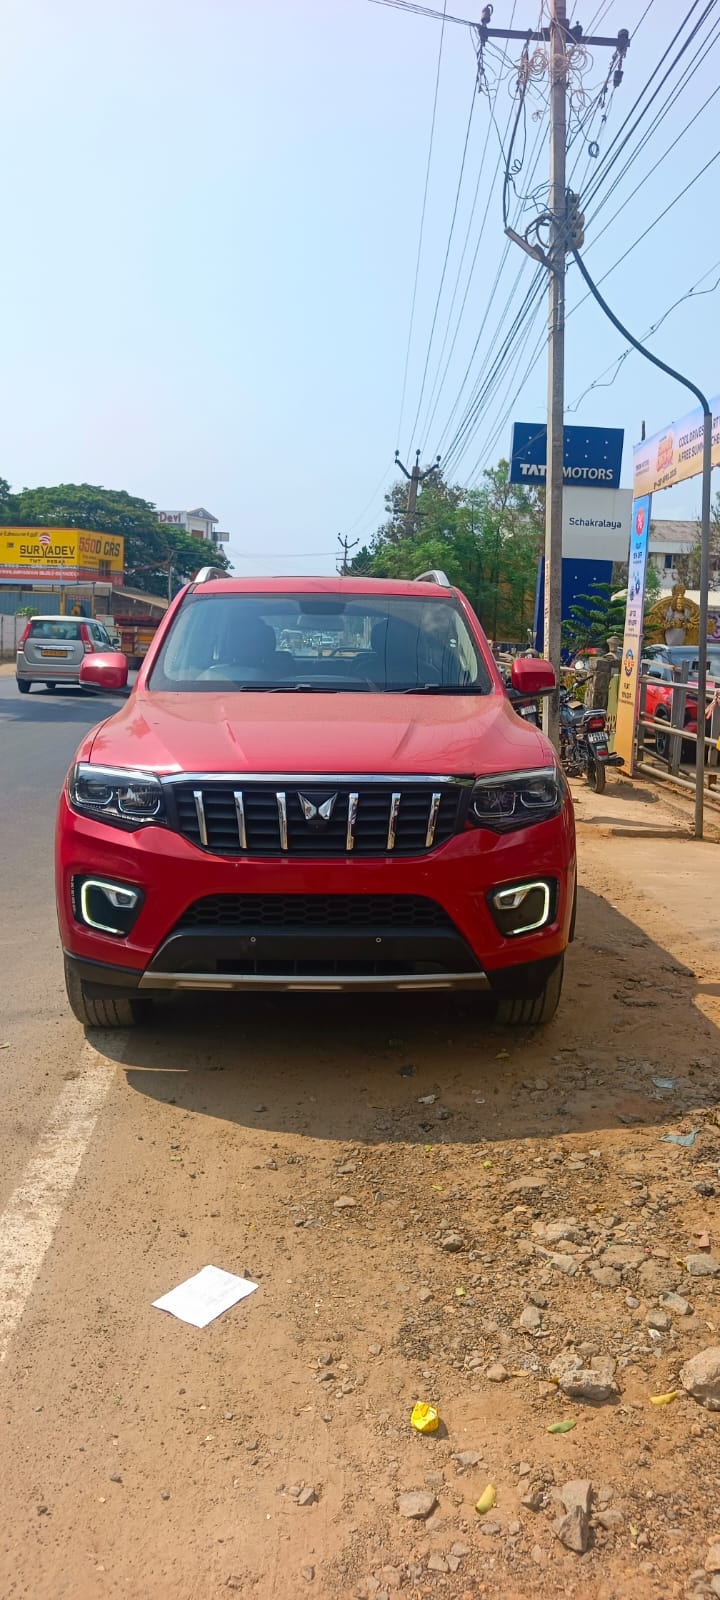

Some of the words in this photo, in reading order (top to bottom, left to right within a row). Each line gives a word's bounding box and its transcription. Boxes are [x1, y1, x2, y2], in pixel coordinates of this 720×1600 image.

[520, 464, 548, 476] TAT
[562, 466, 613, 480] MOTORS
[160, 511, 182, 523] Devi
[569, 517, 622, 530] Schakralaya
[20, 544, 75, 557] SURYADEV
[104, 541, 120, 557] CRS
